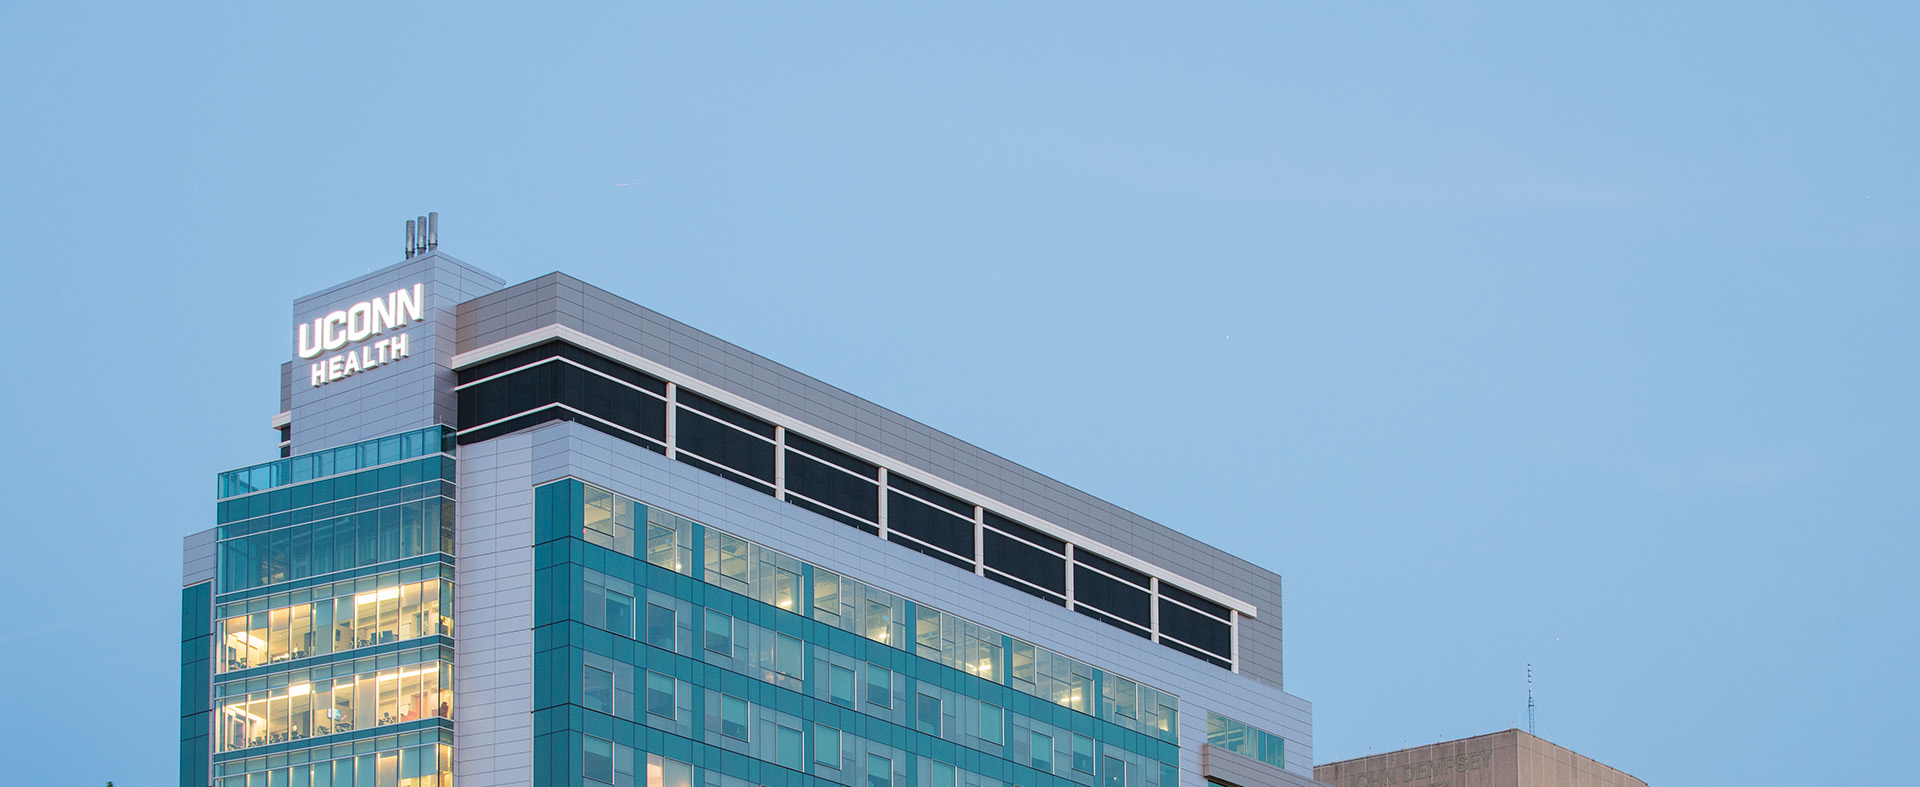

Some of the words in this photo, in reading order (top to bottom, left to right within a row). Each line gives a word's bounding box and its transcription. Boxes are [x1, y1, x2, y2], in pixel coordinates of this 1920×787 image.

[299, 283, 424, 358] UCONN
[311, 333, 409, 386] HEALTH
[1403, 750, 1493, 782] DEMPSEY
